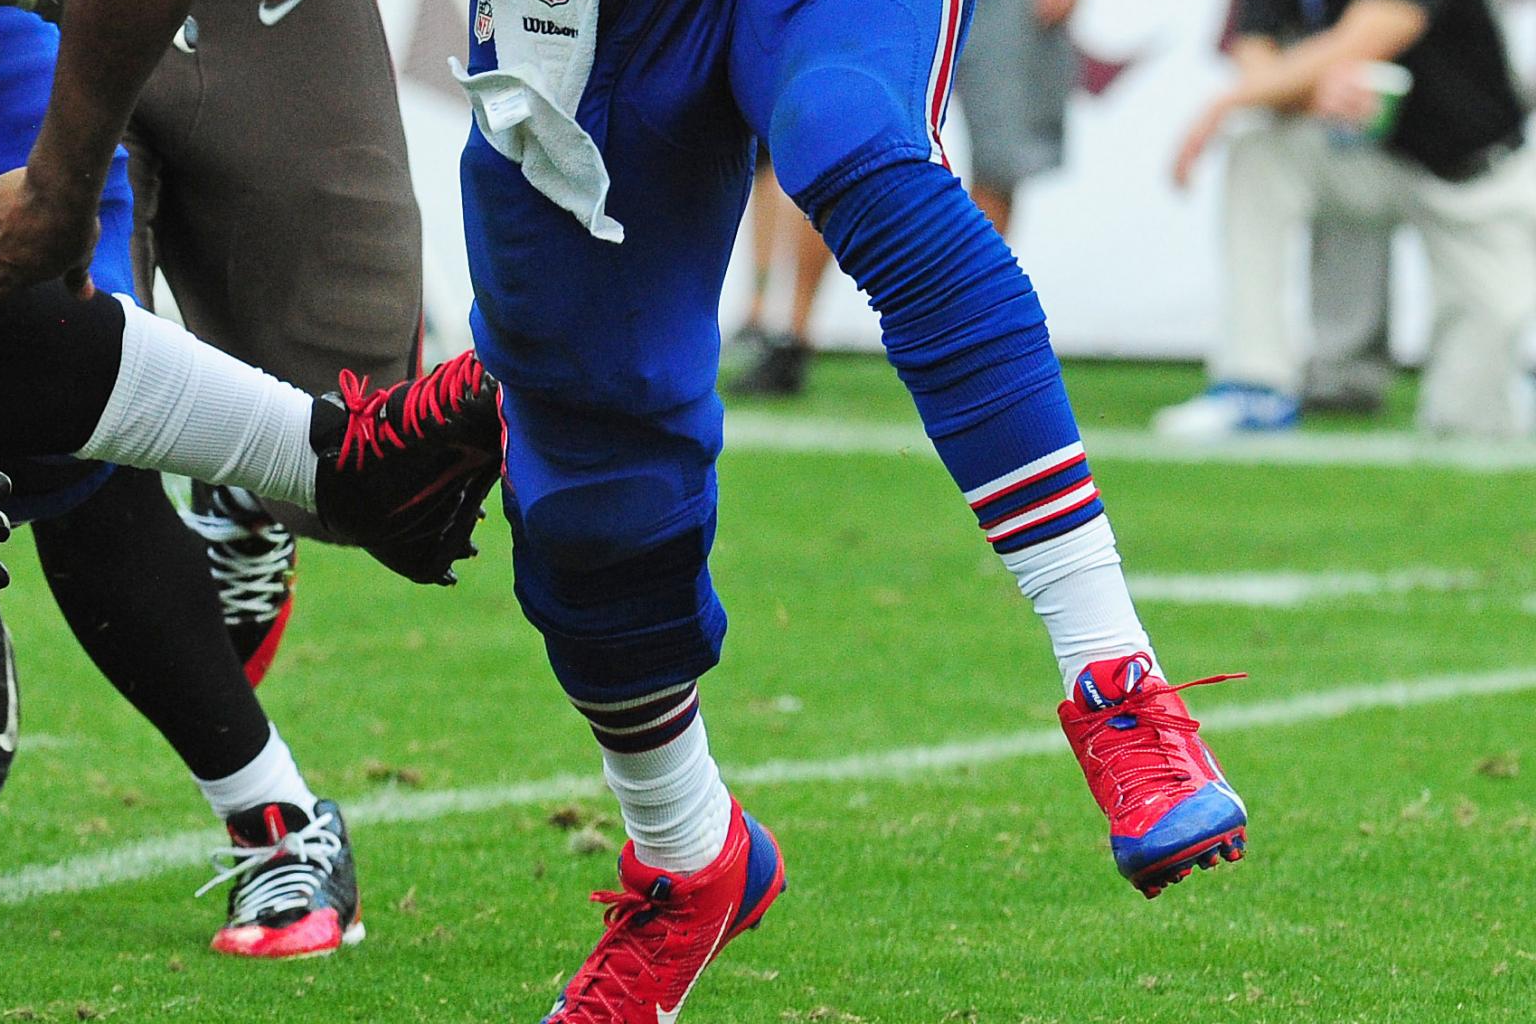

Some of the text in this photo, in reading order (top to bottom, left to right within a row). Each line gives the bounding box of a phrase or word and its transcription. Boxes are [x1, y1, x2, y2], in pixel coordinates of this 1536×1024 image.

[477, 15, 493, 36] NFL
[522, 15, 579, 39] Wilson
[1083, 679, 1104, 706] ALPHA
